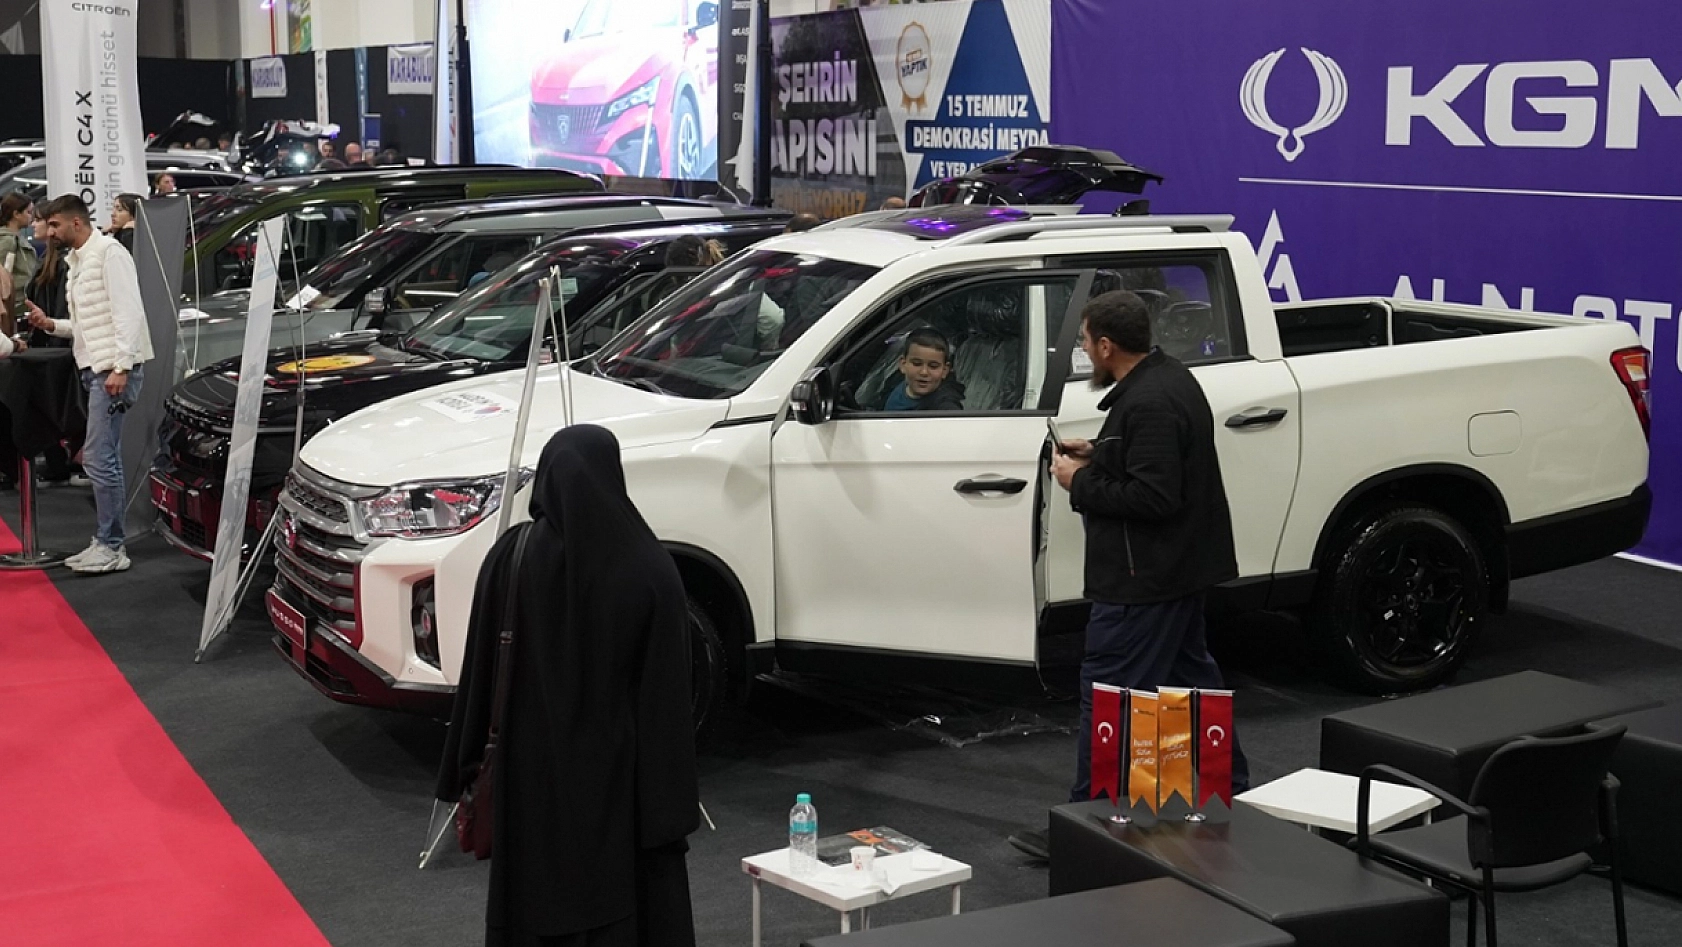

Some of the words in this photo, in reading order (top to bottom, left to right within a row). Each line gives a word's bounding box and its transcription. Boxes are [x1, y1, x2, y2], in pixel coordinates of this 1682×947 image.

[100, 29, 117, 88] hisset
[778, 51, 857, 112] ŞEHRİN
[75, 90, 93, 107] X
[947, 94, 963, 117] 15
[965, 94, 1029, 118] TEMMUZ
[77, 114, 94, 146] C4
[101, 94, 124, 166] gücünü
[912, 122, 994, 150] DEMOKRASİ
[930, 160, 945, 178] VE
